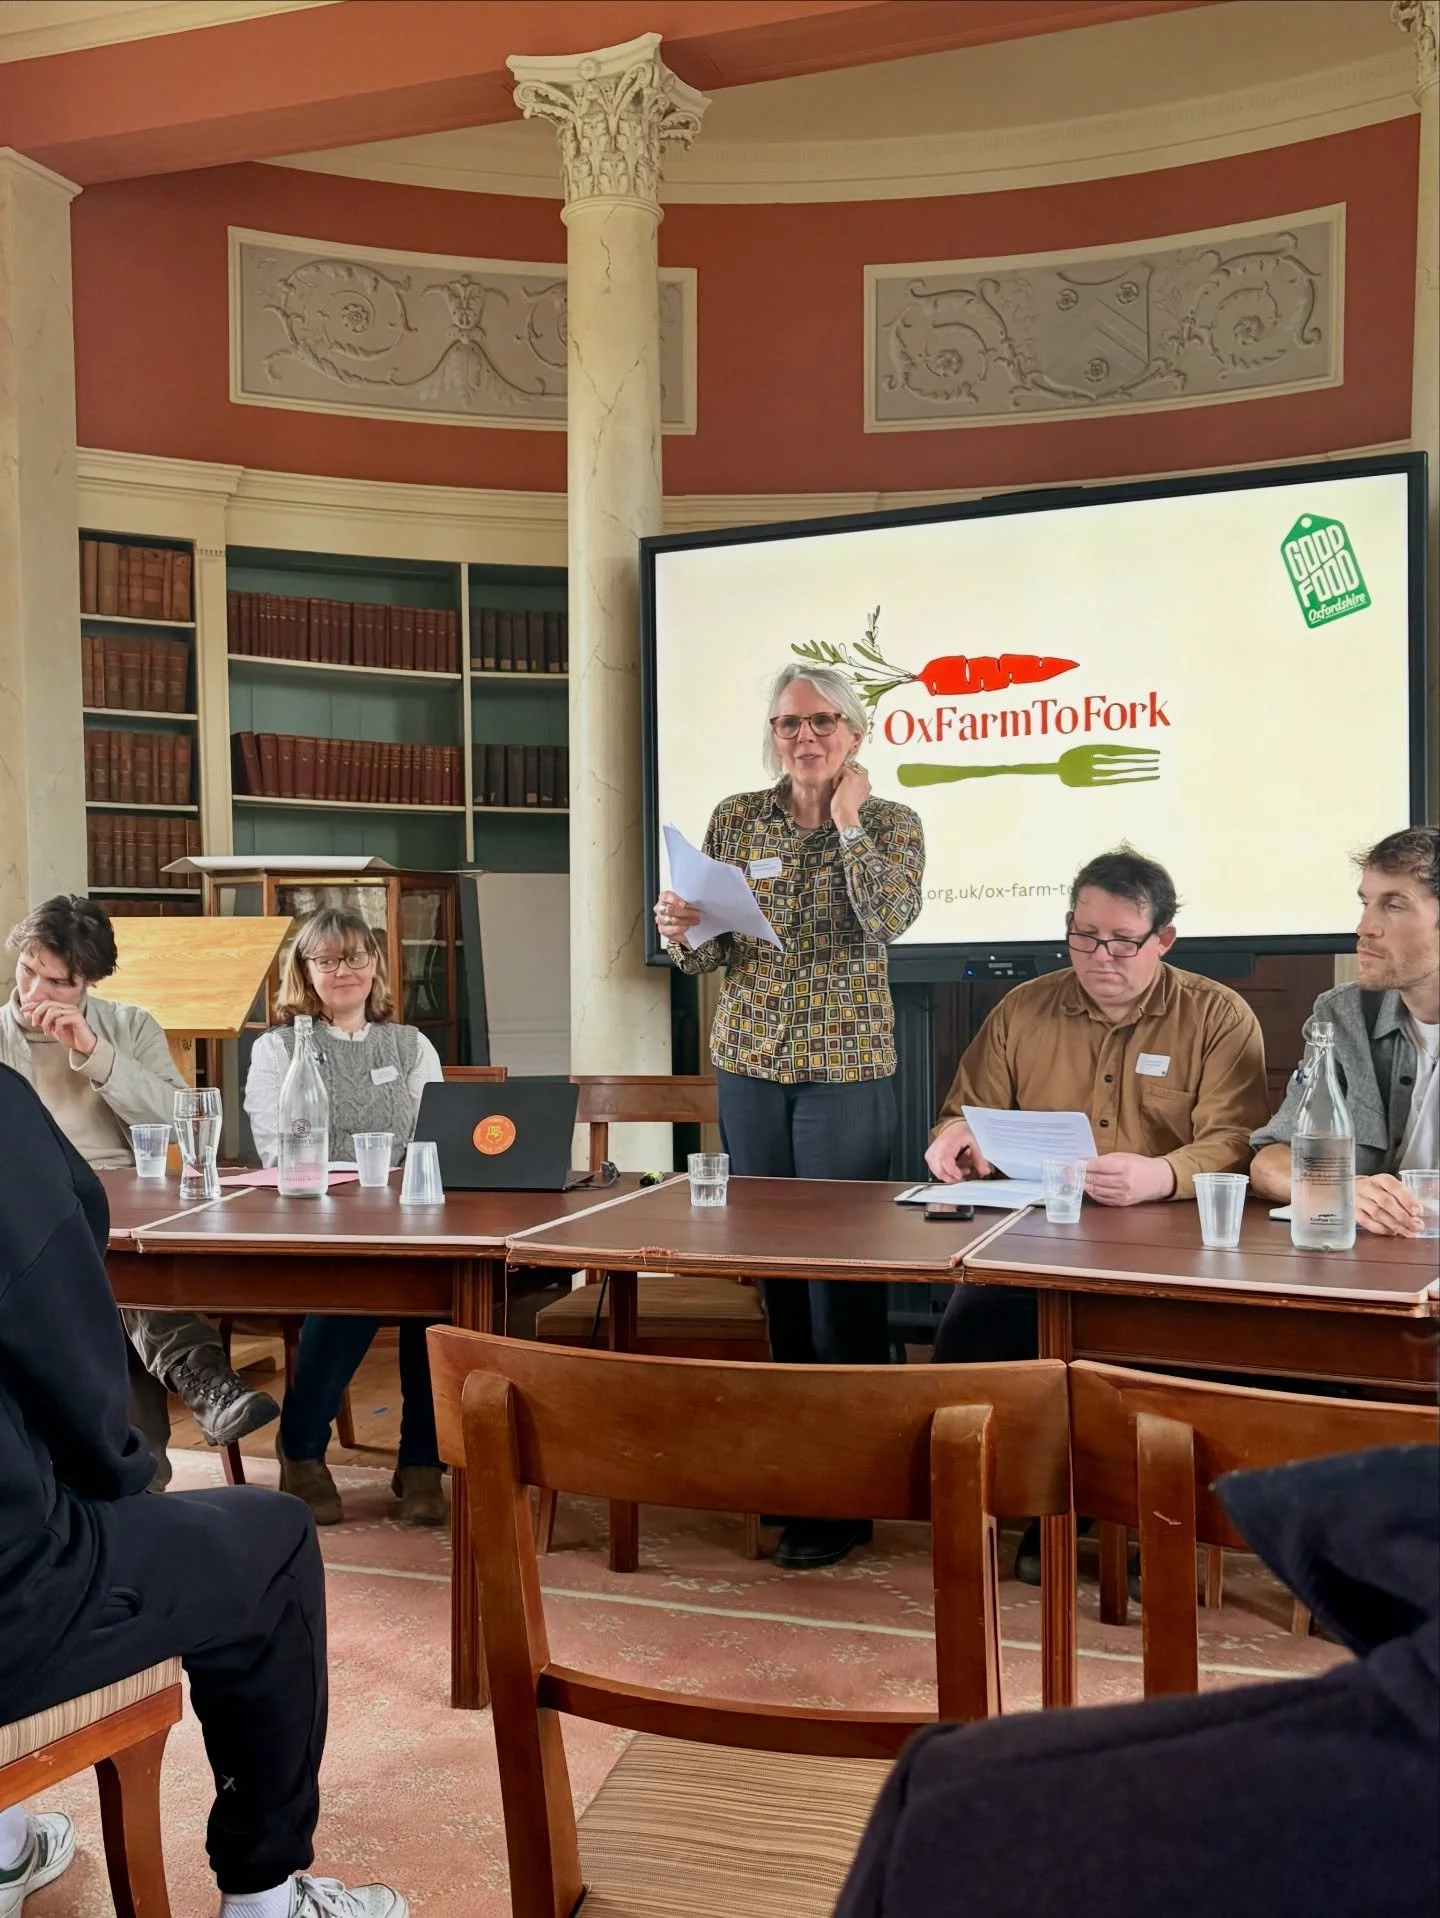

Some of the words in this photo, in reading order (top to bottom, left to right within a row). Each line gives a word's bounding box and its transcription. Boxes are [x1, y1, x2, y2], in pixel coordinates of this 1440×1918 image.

[1284, 524, 1345, 582] GOOD
[1298, 549, 1360, 608] FOOD
[1308, 593, 1366, 622] Oxfordshire
[884, 691, 1171, 746] OxFarmToFork
